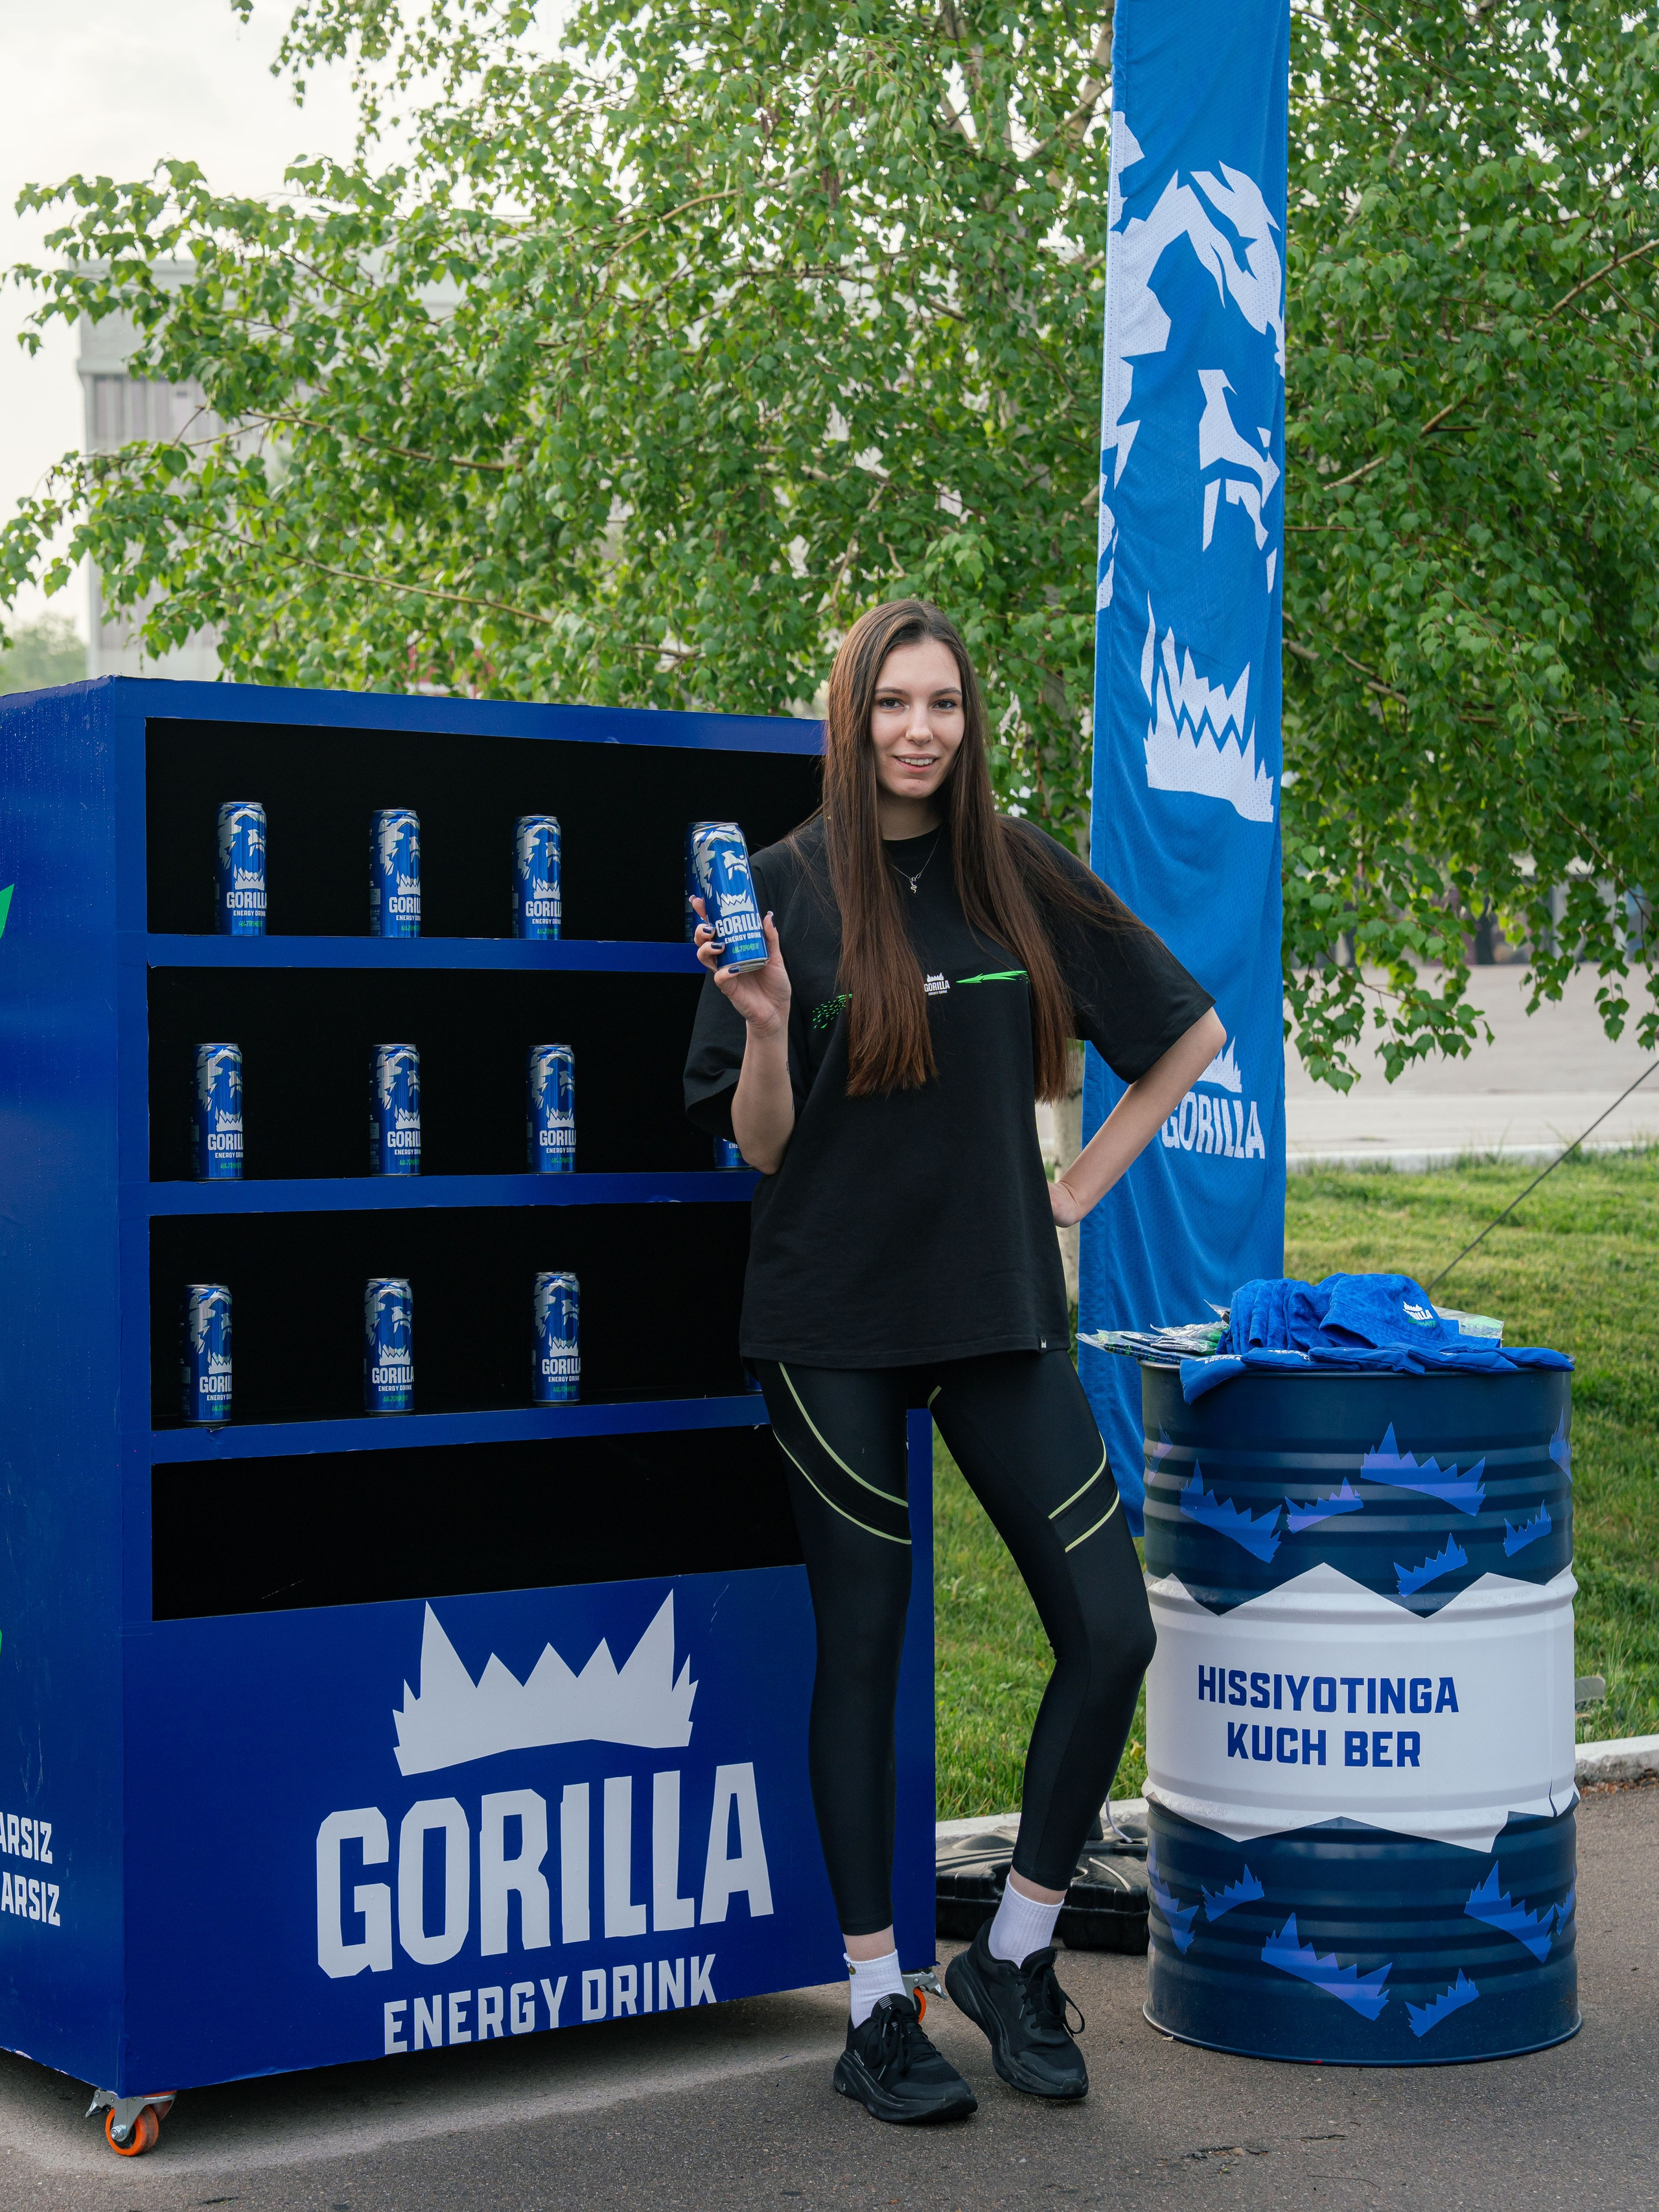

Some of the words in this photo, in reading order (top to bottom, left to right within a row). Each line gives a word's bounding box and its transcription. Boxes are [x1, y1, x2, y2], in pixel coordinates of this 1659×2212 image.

[389, 896, 421, 913] GORILL
[526, 901, 561, 917] GORILL
[715, 913, 763, 937] GORILLA
[725, 934, 746, 944] ENERGY
[732, 943, 759, 953] ULTIMATE
[924, 980, 950, 992] GORILLA
[1162, 1091, 1265, 1159] GORILLA
[207, 1134, 244, 1150] GORILL
[388, 1131, 421, 1147] GORILL
[540, 1130, 576, 1146] GORILL
[200, 1375, 232, 1393] GORILL
[372, 1366, 414, 1384] GORILLA
[1198, 1664, 1459, 1714] HISSIYOTINGA
[1227, 1721, 1327, 1765] KUCH
[1345, 1731, 1421, 1767] BER
[316, 1762, 774, 1979] GORILLA
[1, 1872, 60, 1927] ARSIZ
[384, 1976, 568, 2055] ENERGY
[583, 1953, 716, 2021] DRINK
